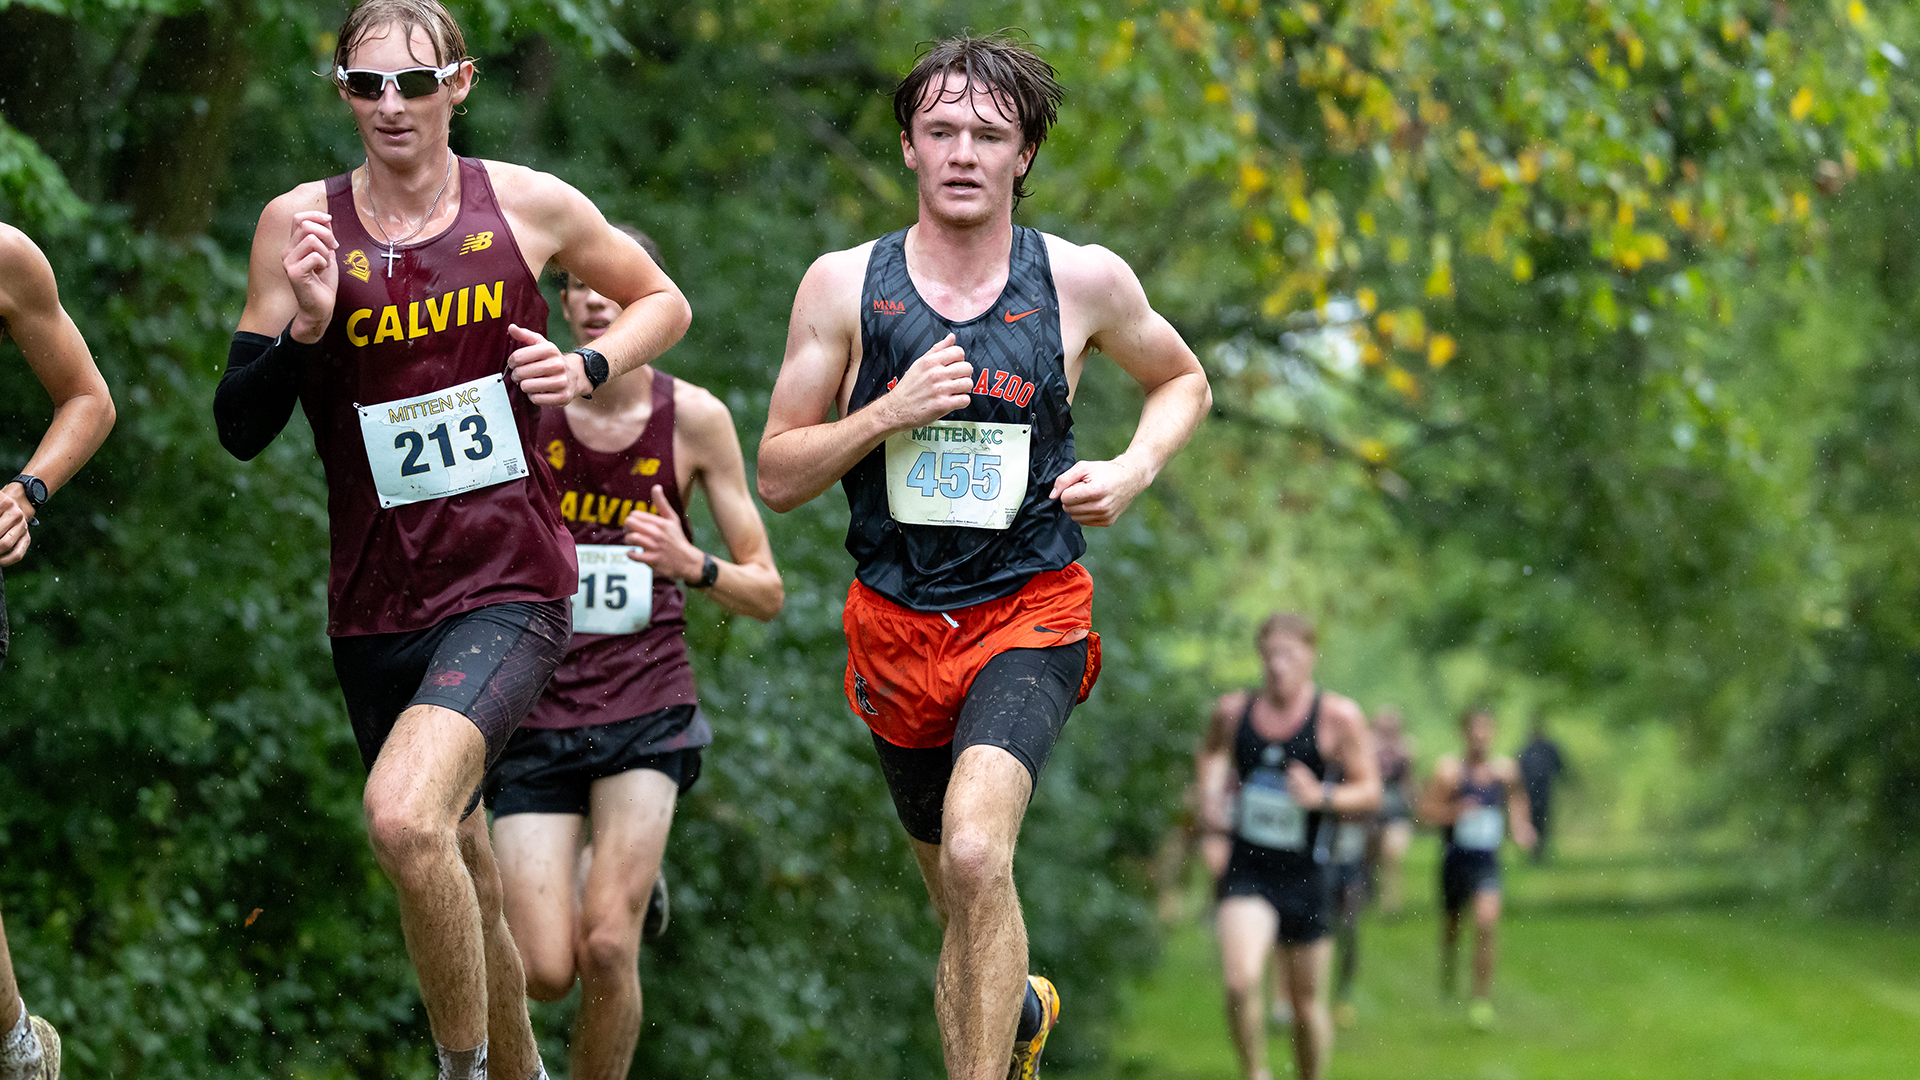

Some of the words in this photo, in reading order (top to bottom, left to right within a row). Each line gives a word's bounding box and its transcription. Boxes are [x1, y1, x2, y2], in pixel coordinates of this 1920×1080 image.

[346, 280, 505, 348] CALVIN
[873, 299, 906, 311] MIAA
[388, 394, 454, 424] MITTEN
[455, 387, 481, 408] XC
[394, 414, 494, 478] 213
[911, 425, 976, 443] MITTEN
[980, 428, 1004, 445] XC
[906, 451, 1002, 501] 455
[560, 490, 658, 527] ALVI
[571, 573, 628, 610] 15
